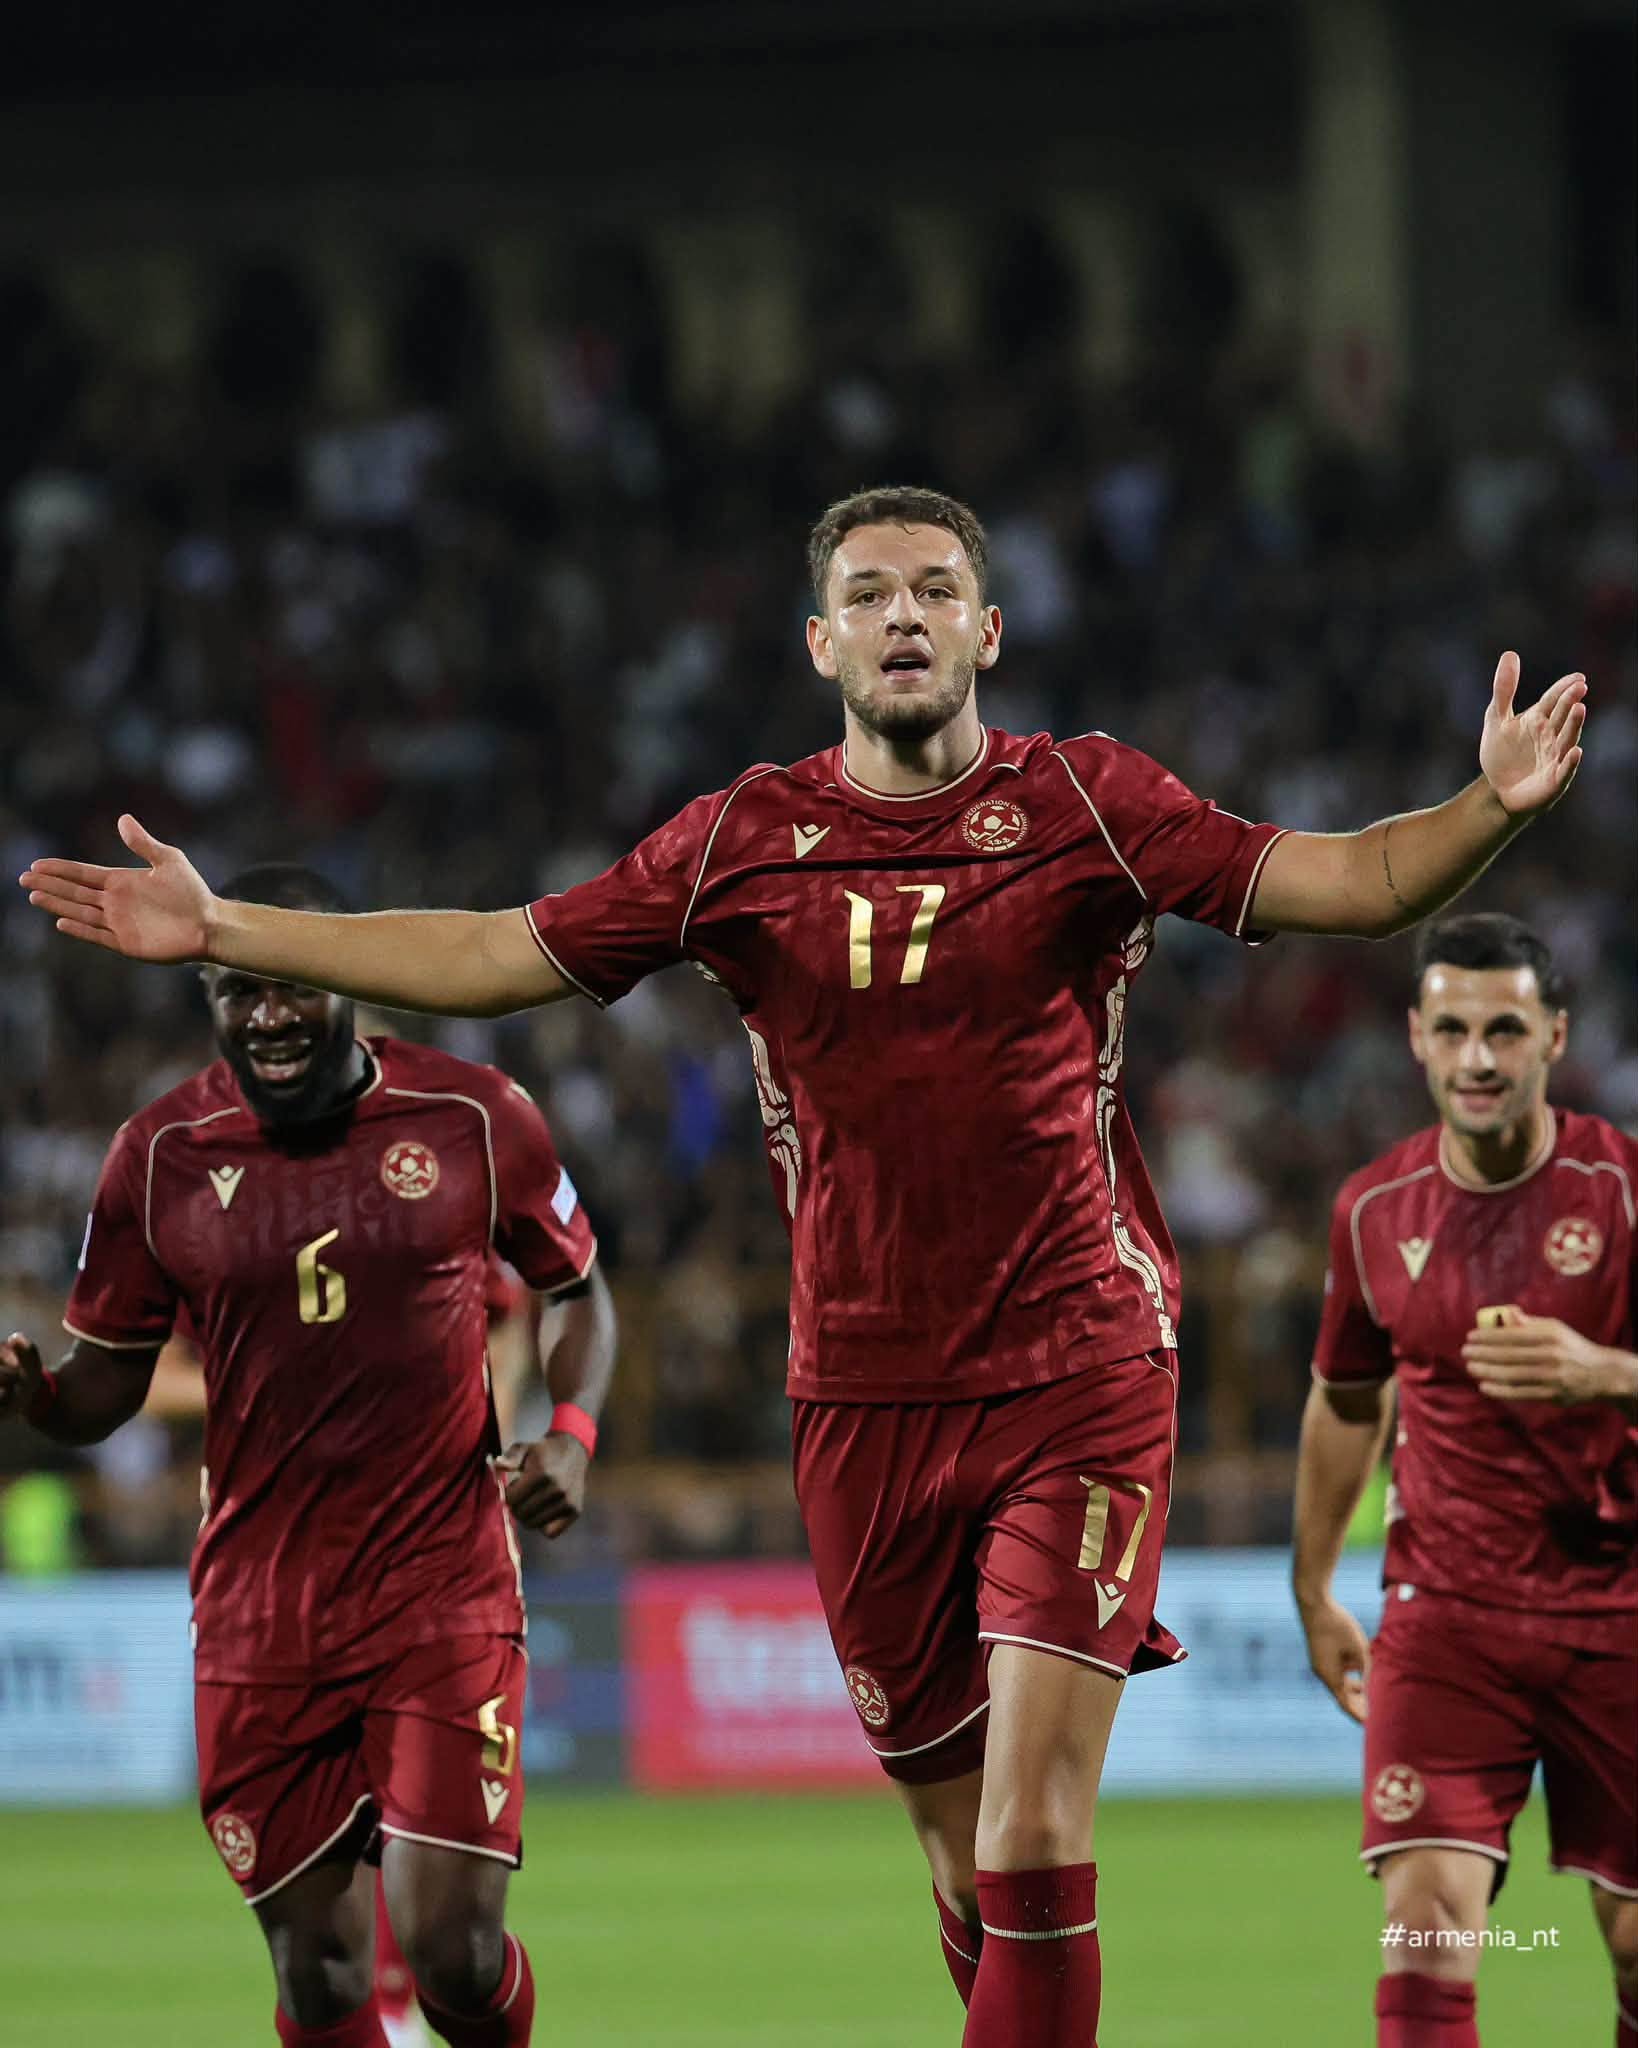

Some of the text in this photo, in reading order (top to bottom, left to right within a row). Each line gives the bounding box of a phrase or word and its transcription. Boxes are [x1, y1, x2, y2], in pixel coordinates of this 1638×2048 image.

[965, 799, 1010, 820] FEDERATION
[1010, 804, 1021, 814] OF
[843, 884, 946, 989] 17
[296, 1228, 346, 1324] 6
[1077, 1475, 1152, 1583] 17
